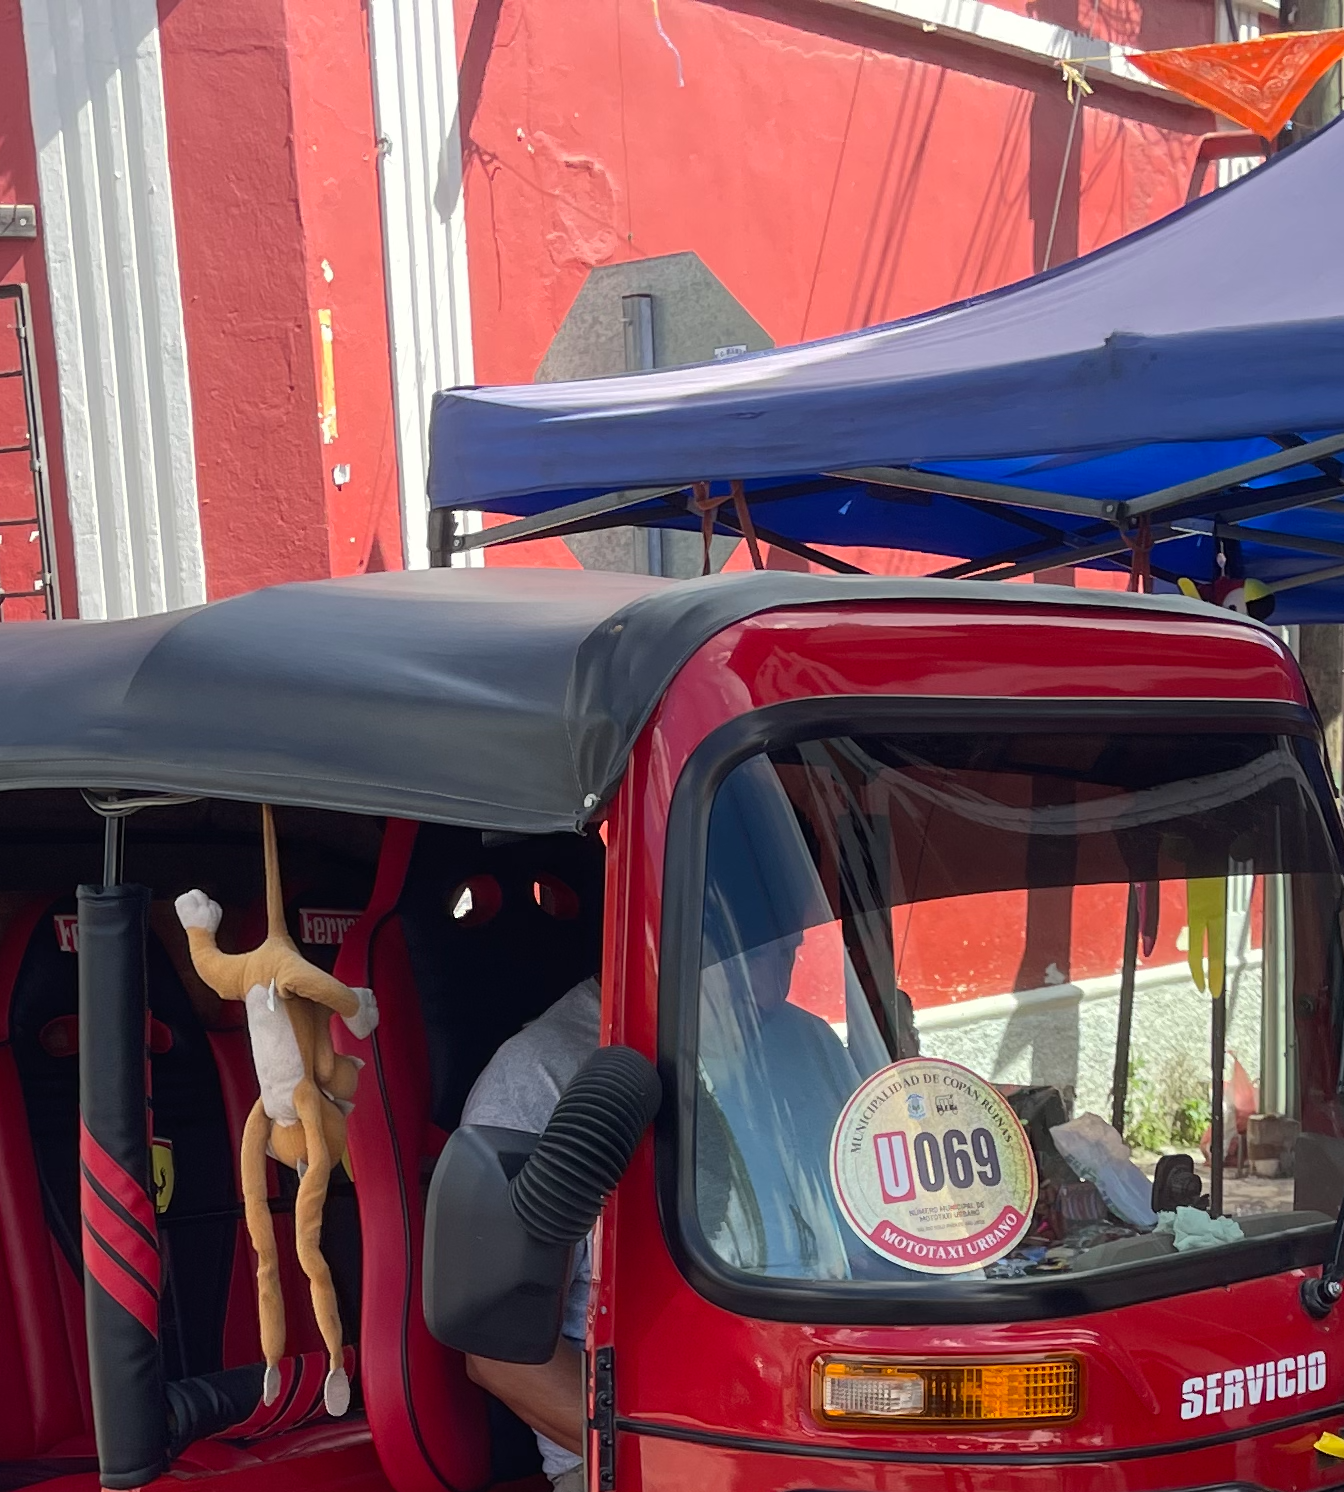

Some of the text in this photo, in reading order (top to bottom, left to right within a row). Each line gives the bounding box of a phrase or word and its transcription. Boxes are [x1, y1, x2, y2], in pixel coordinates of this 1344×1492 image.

[850, 1074, 920, 1154] MUNICIPALIDAD
[923, 1073, 941, 1084] DE
[980, 1099, 1013, 1144] RUINAS
[881, 1213, 1018, 1260] MOTOTAXI URBANO
[1180, 1350, 1326, 1420] SERVICIO
